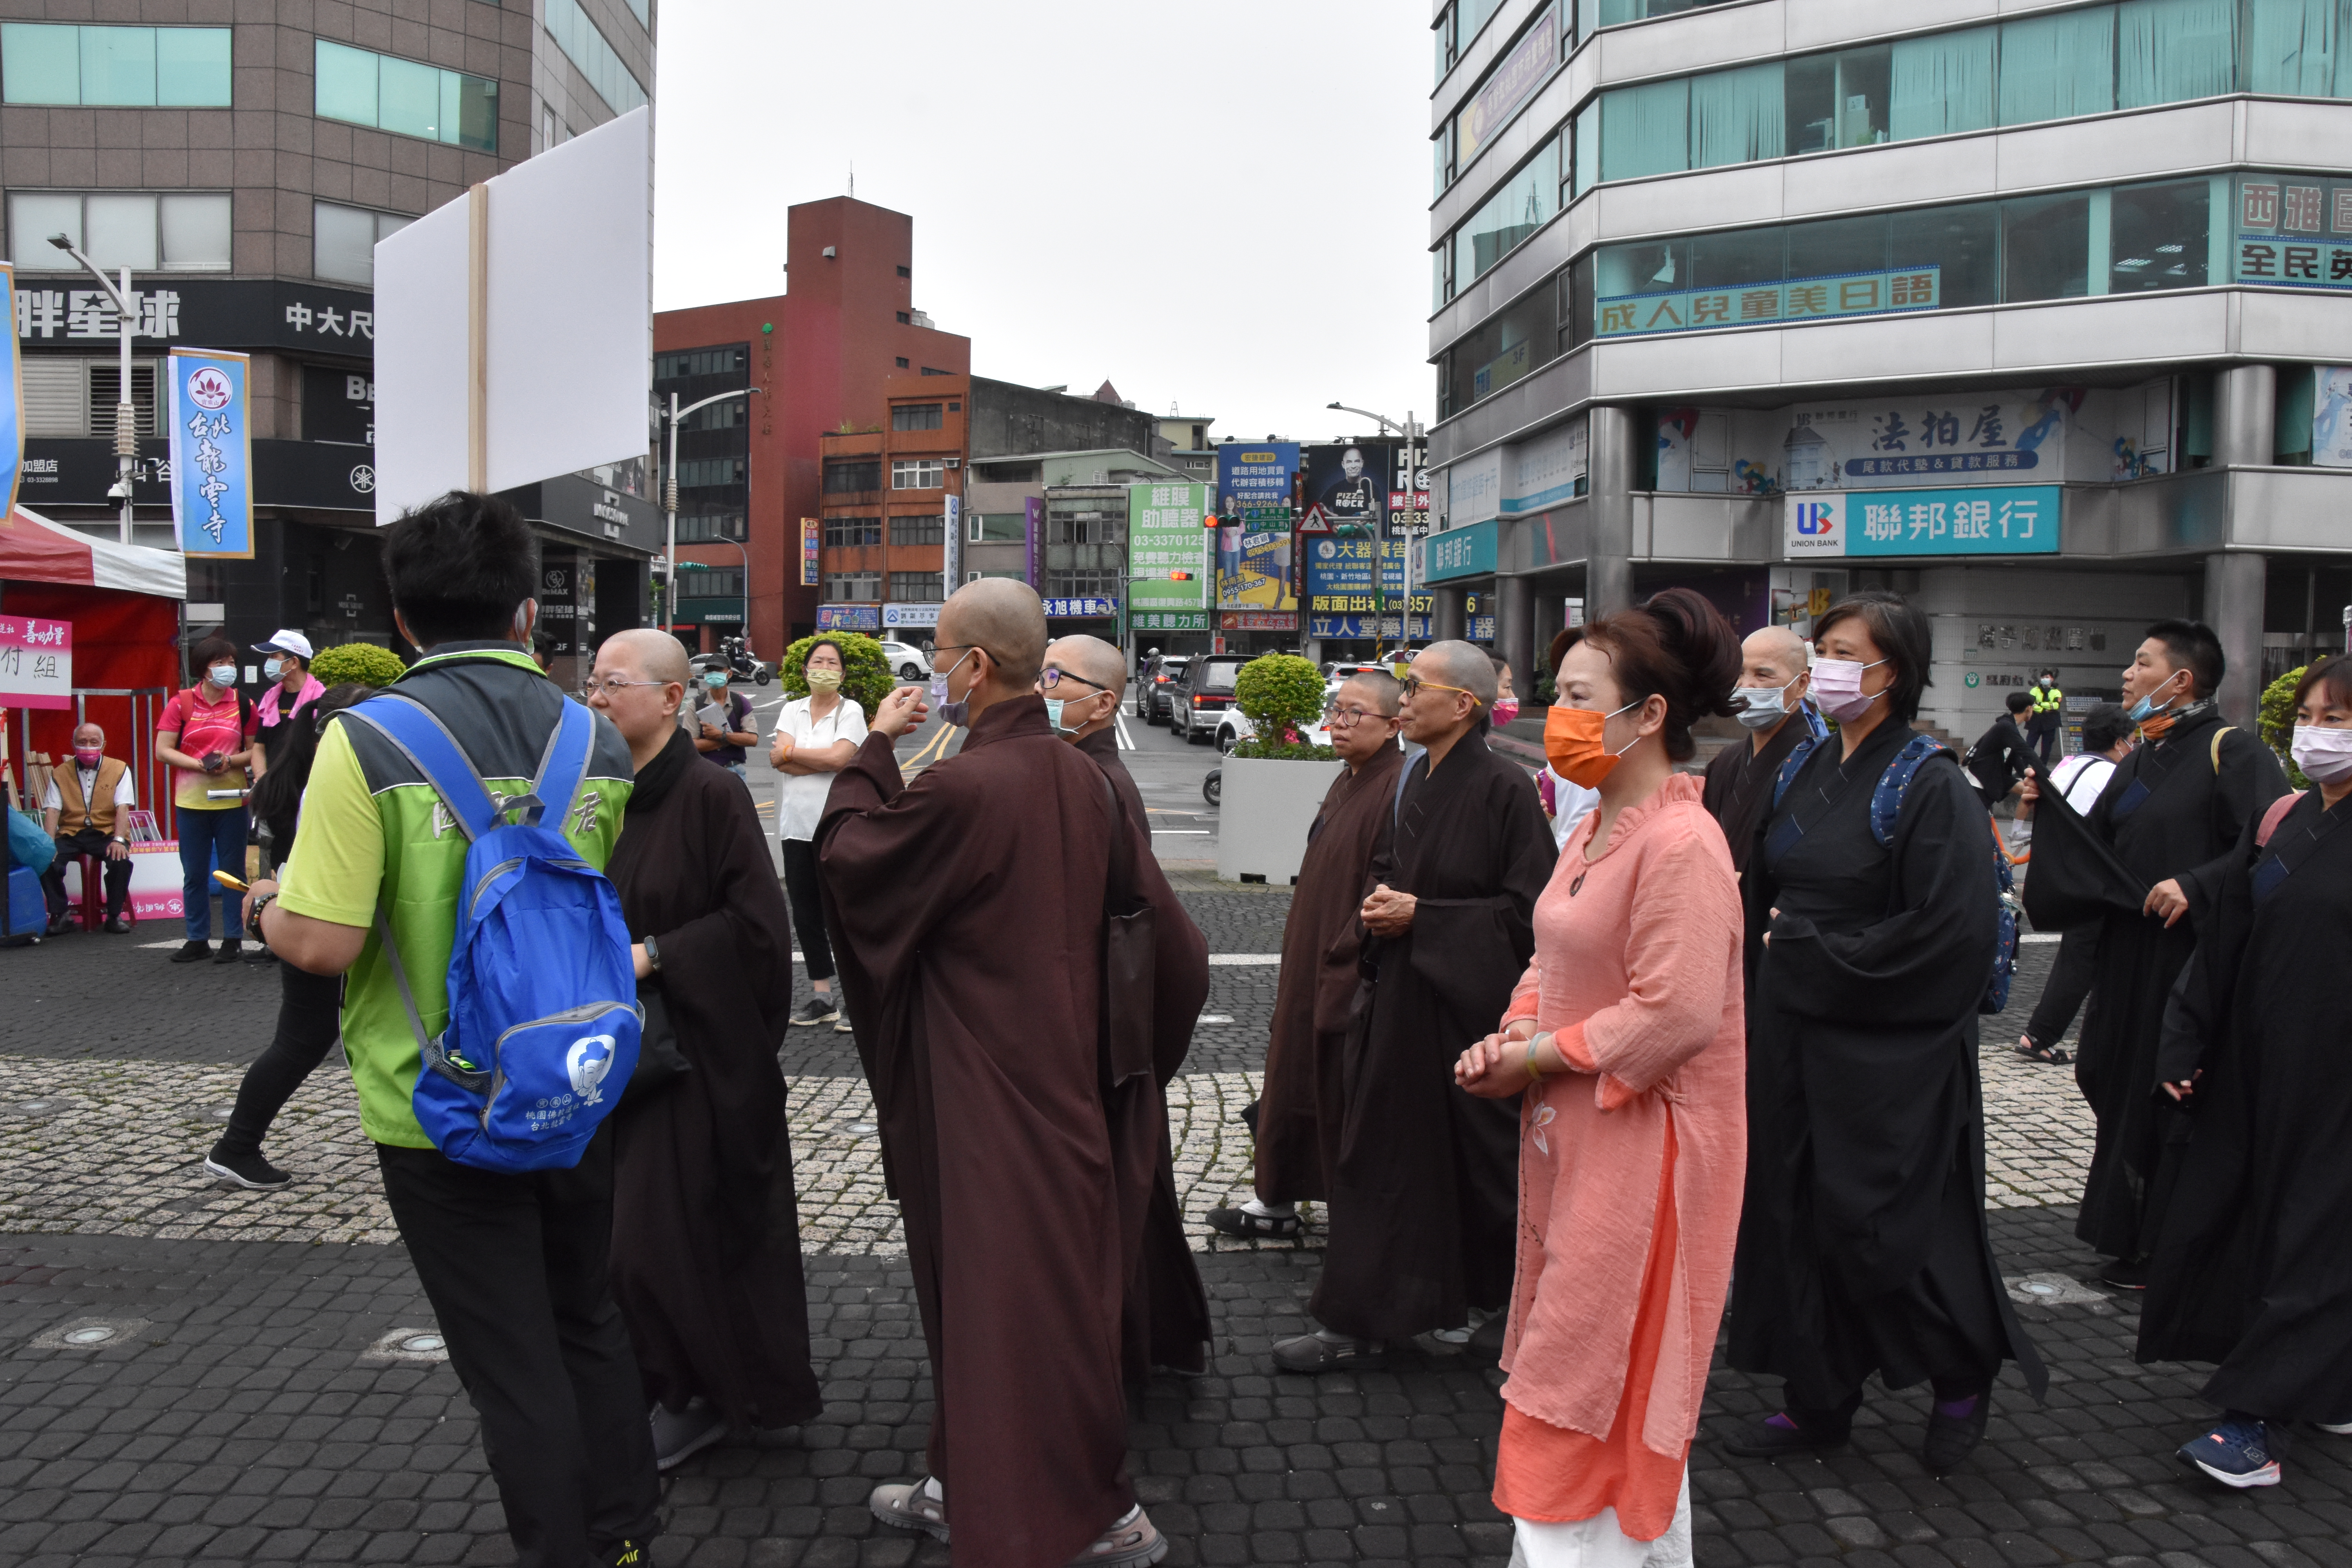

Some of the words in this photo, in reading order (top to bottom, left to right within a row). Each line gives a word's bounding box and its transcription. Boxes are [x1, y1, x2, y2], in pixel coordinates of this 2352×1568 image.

[1601, 273, 1933, 332] 成人兒童美日語
[188, 411, 232, 439] 台北
[1872, 404, 2007, 451] 法拍屋
[1231, 466, 1284, 475] 道路用地買賣
[1231, 477, 1284, 487] 代辦容積移轉
[1392, 495, 1429, 506] 披外
[1142, 508, 1199, 528] 助聽器
[1864, 500, 2038, 541] 聯邦銀行
[1134, 535, 1203, 546] 03-3370125
[1133, 552, 1203, 564] 免費聽力檢查
[1436, 536, 1472, 571] 聯邦銀行
[1222, 578, 1266, 597] 0955-170-367
[1042, 599, 1096, 615] 永旭機車
[1132, 614, 1205, 628] 維美聽力所
[1312, 616, 1432, 638] 立人堂藥局
[22, 620, 64, 645] 善的力量
